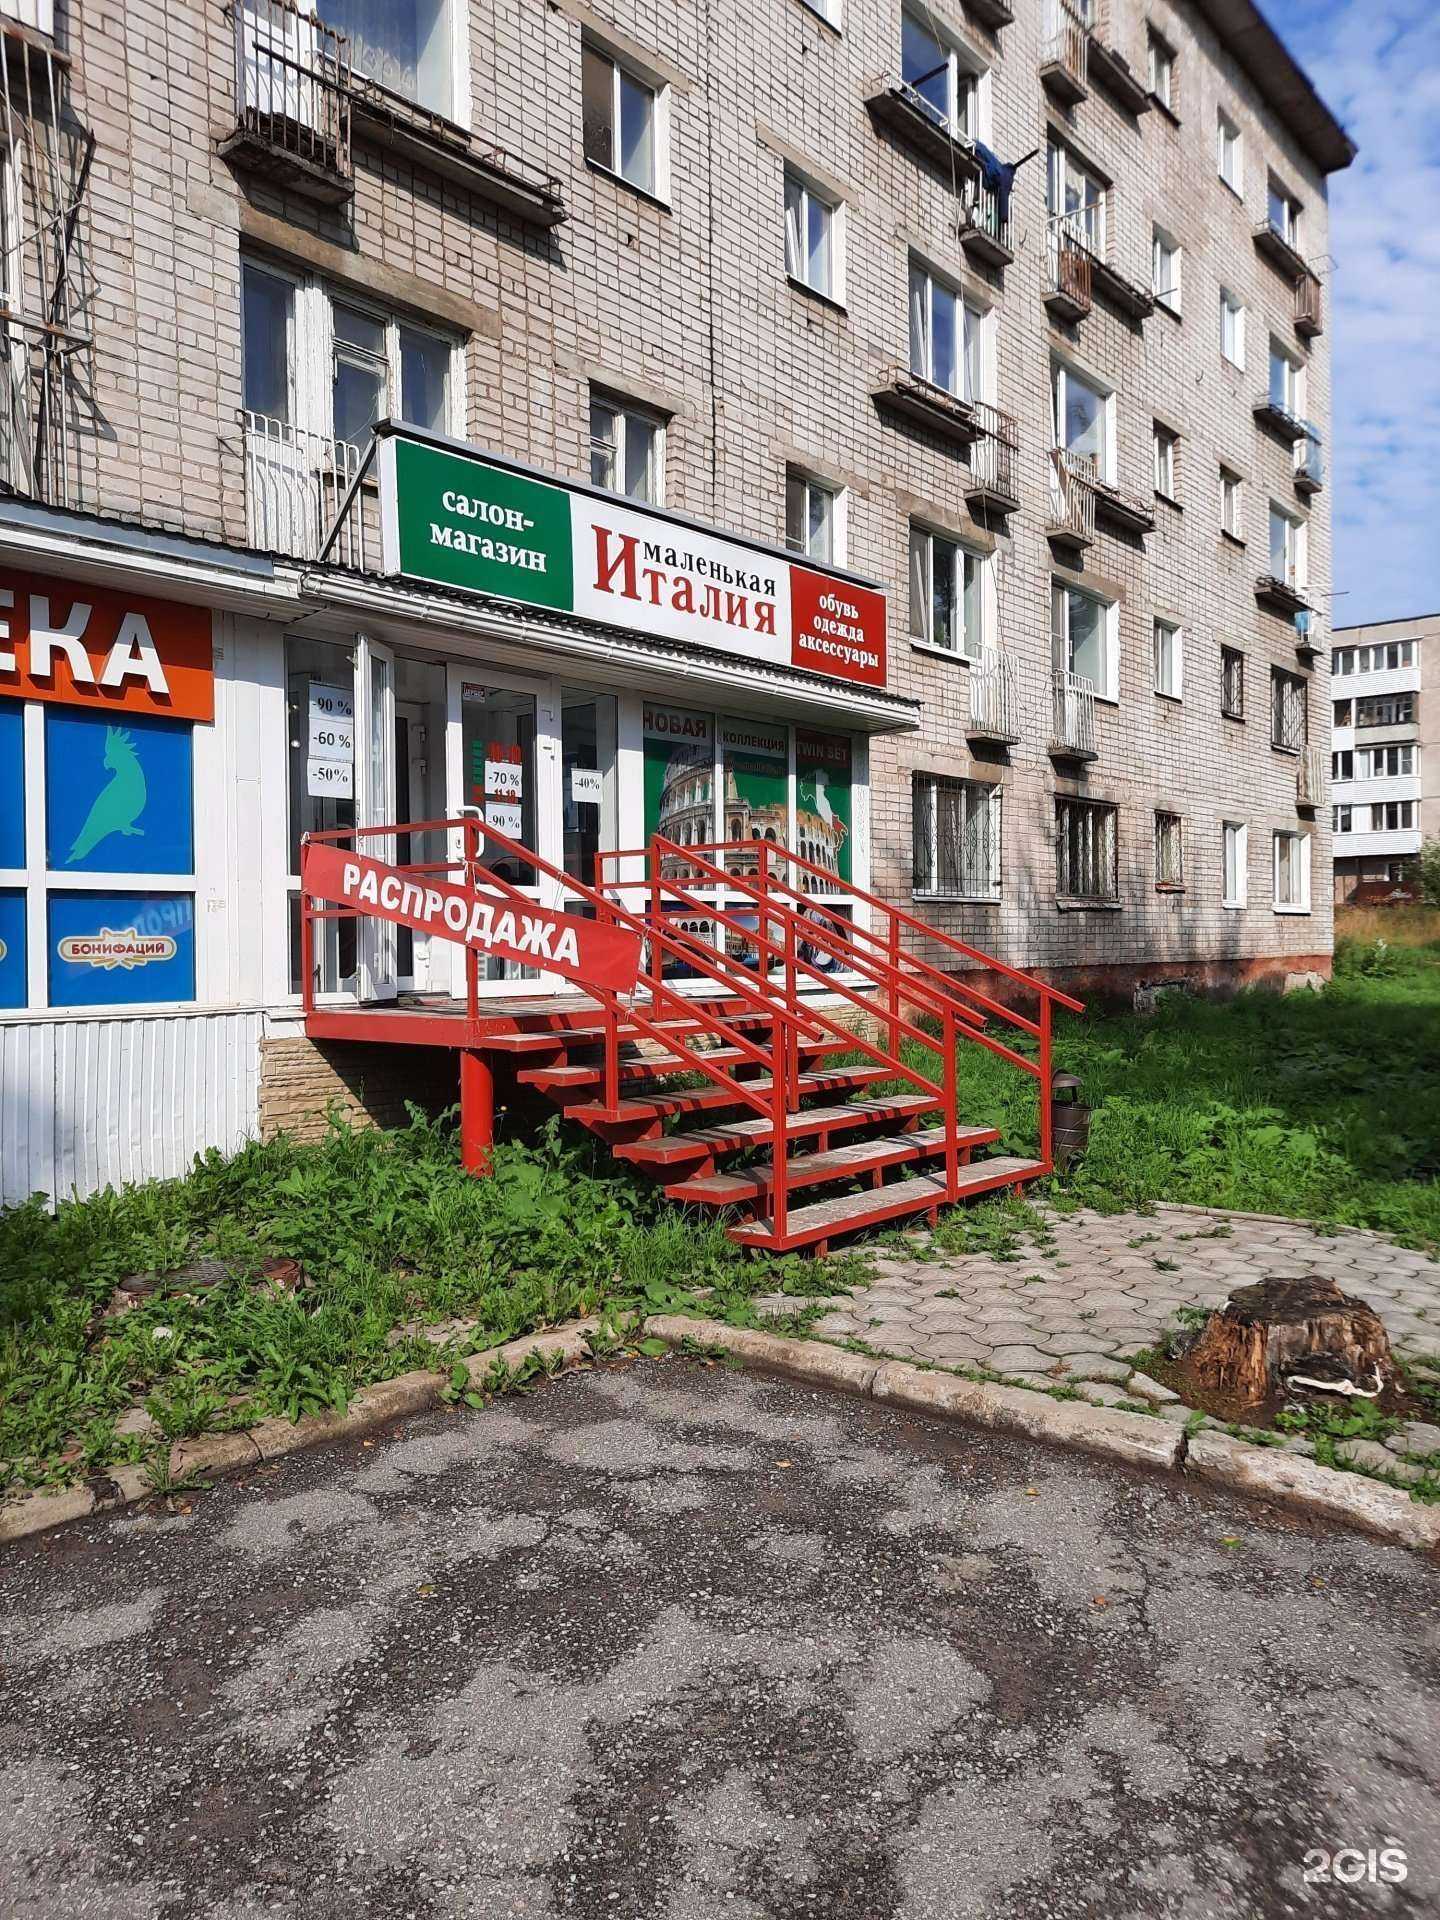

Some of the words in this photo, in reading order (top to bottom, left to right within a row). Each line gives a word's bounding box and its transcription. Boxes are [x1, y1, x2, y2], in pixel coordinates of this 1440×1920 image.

[442, 490, 535, 532] салон-
[429, 522, 547, 573] магазин
[590, 523, 777, 636] Италия
[643, 541, 776, 597] маленькая
[819, 593, 859, 619] обувь
[813, 615, 865, 643] одежда
[798, 633, 879, 669] аксессуары
[312, 697, 333, 712] -90
[337, 699, 352, 715] %
[312, 731, 335, 746] -60
[338, 734, 351, 748] %
[643, 711, 707, 739] НОВАЯ
[722, 731, 785, 752] КОЛЛЕКЦИЯ
[312, 767, 348, 783] -50%
[488, 771, 507, 785] -70
[510, 774, 520, 786] %
[574, 777, 600, 790] -40%
[488, 815, 505, 827] -90
[508, 816, 520, 829] %
[343, 863, 580, 968] РАСПРОДАЖА
[71, 942, 165, 955] БОНИФАЦИЙ
